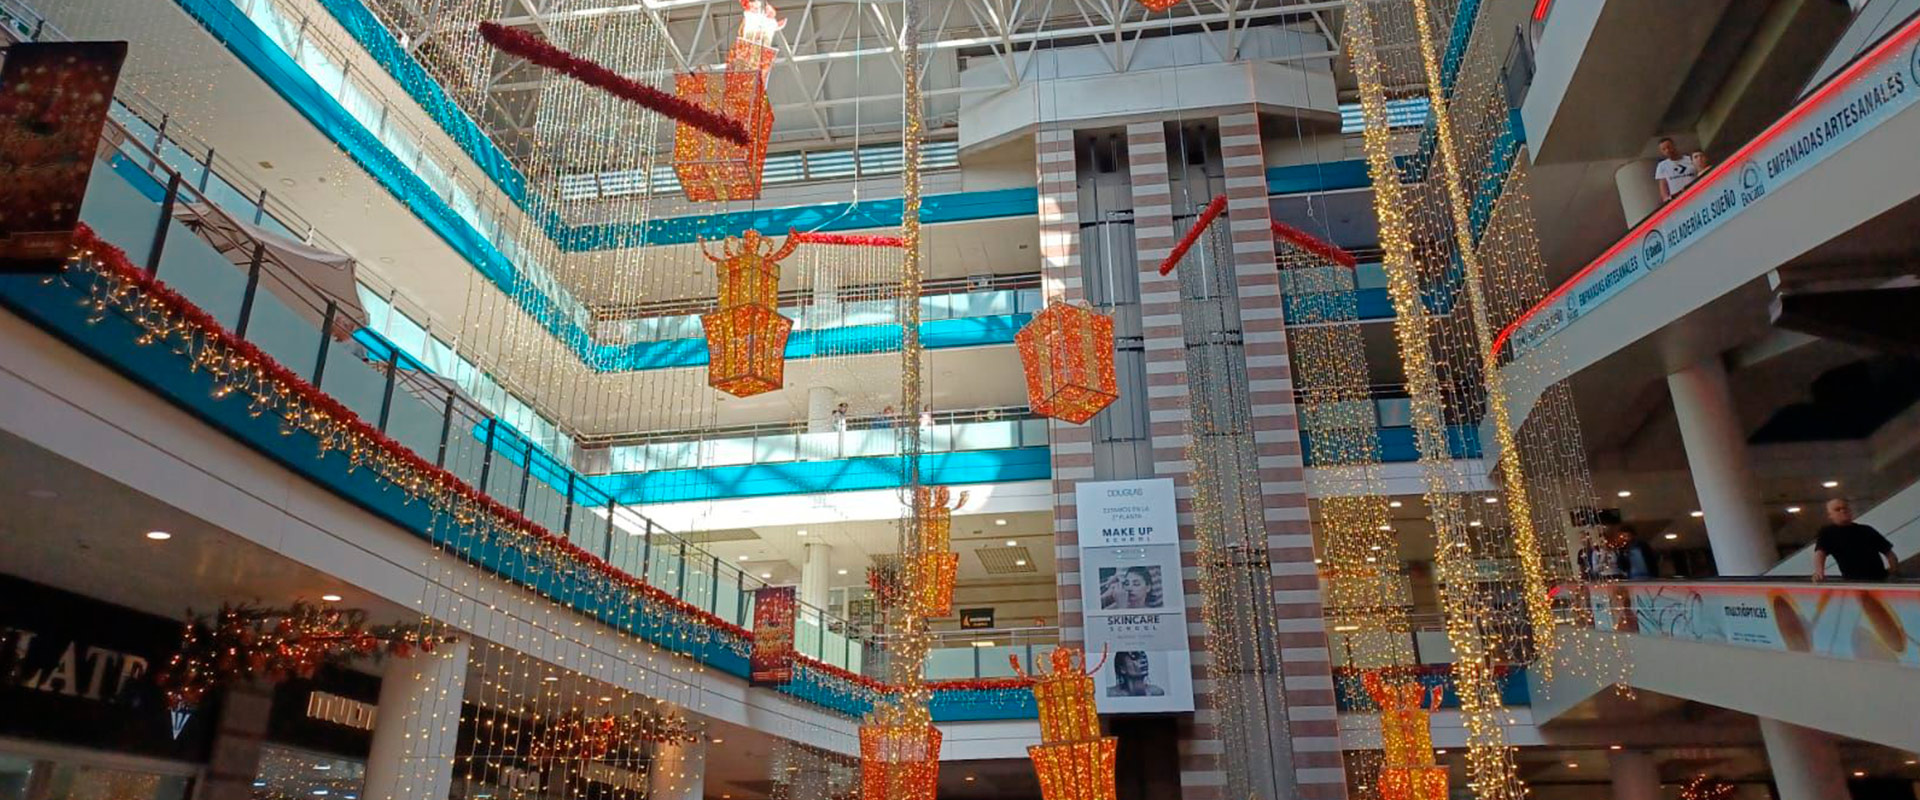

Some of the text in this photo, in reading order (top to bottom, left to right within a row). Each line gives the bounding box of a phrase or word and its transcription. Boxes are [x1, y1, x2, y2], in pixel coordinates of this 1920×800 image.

[1767, 72, 1905, 179] EMPANADAS ARTESANALES
[1667, 189, 1736, 248] HELADERÍA EL SUEÑO
[1102, 526, 1153, 537] MAKE UP
[1108, 614, 1160, 626] SKINCARE
